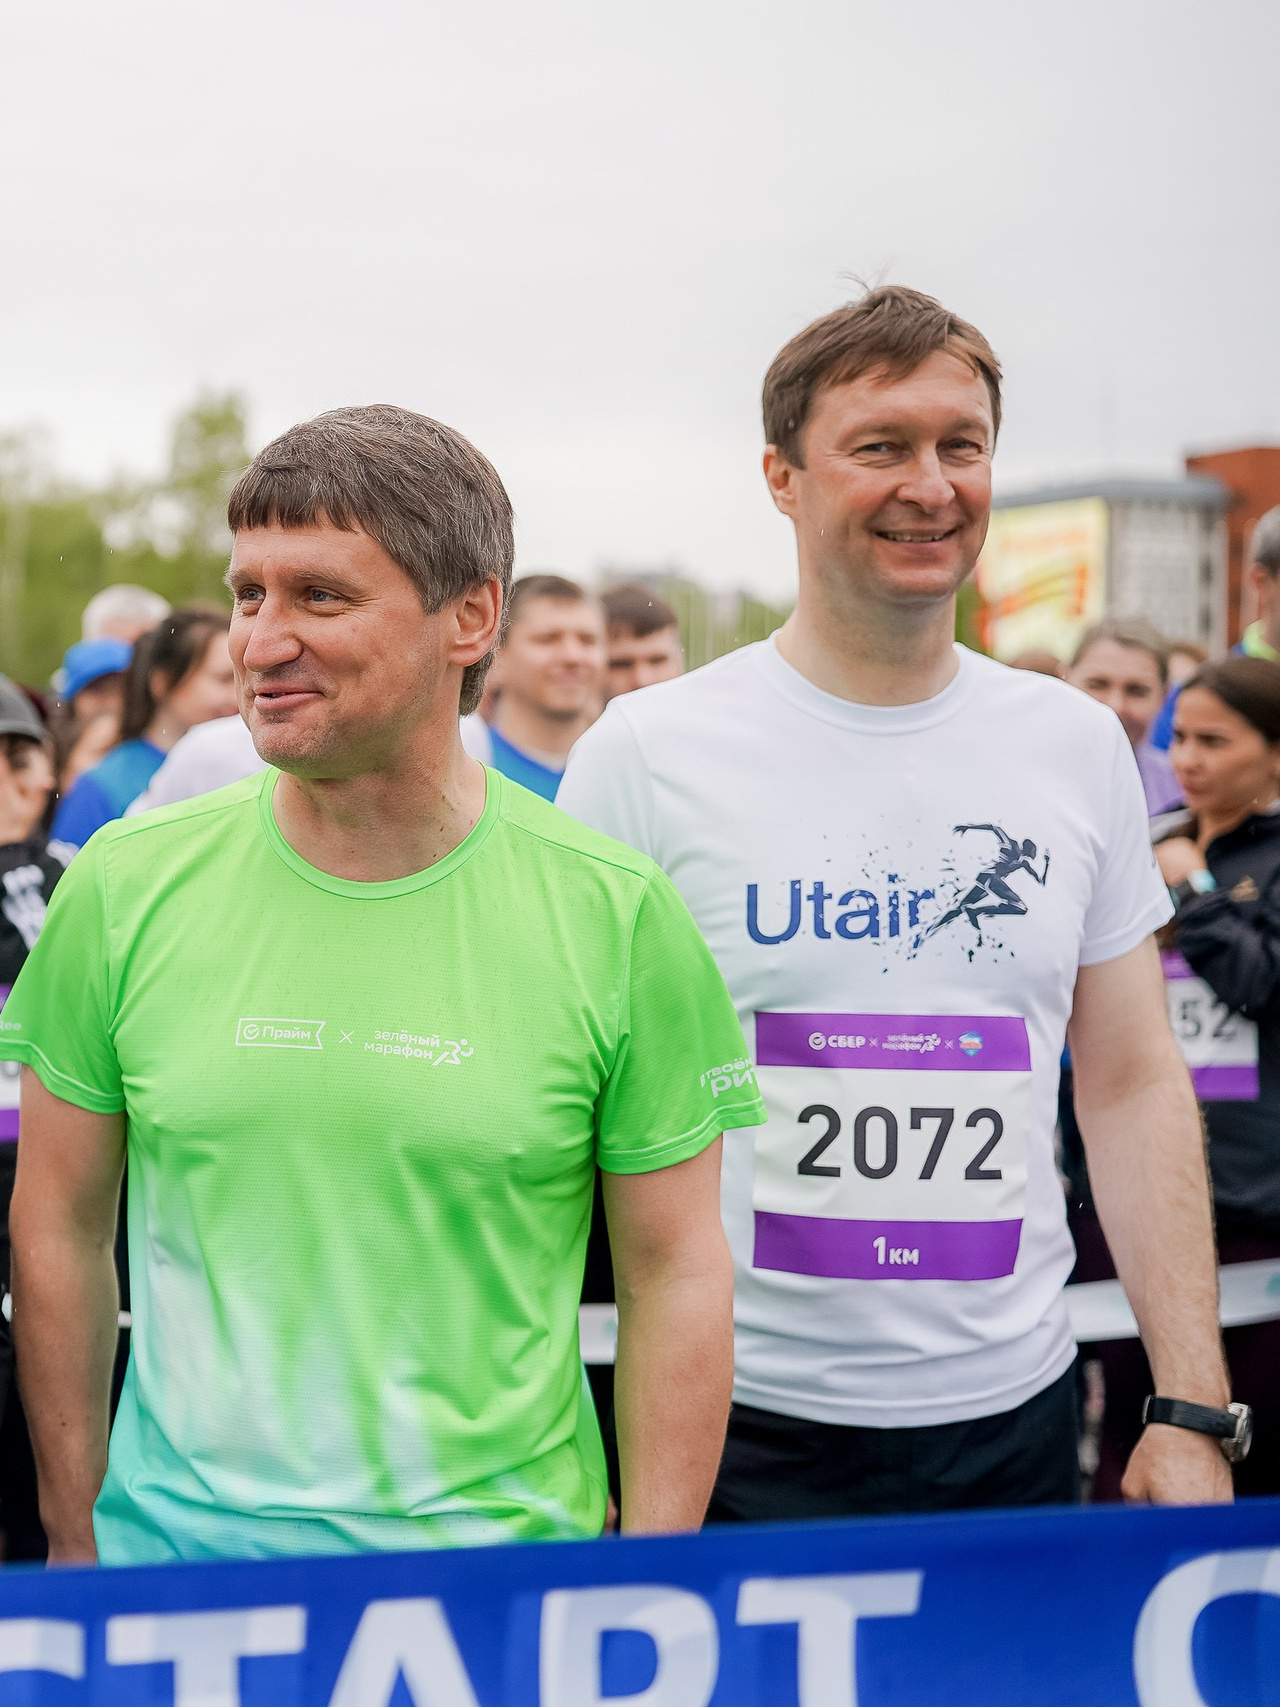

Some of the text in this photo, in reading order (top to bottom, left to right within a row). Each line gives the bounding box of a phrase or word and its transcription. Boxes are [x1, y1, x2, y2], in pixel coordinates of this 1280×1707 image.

[746, 873, 936, 946] Utair
[262, 1025, 311, 1040] Прайм
[373, 1029, 441, 1048] зелёный
[827, 1034, 867, 1049] СБЕР
[364, 1041, 433, 1060] марафон
[796, 1103, 1006, 1182] 2072
